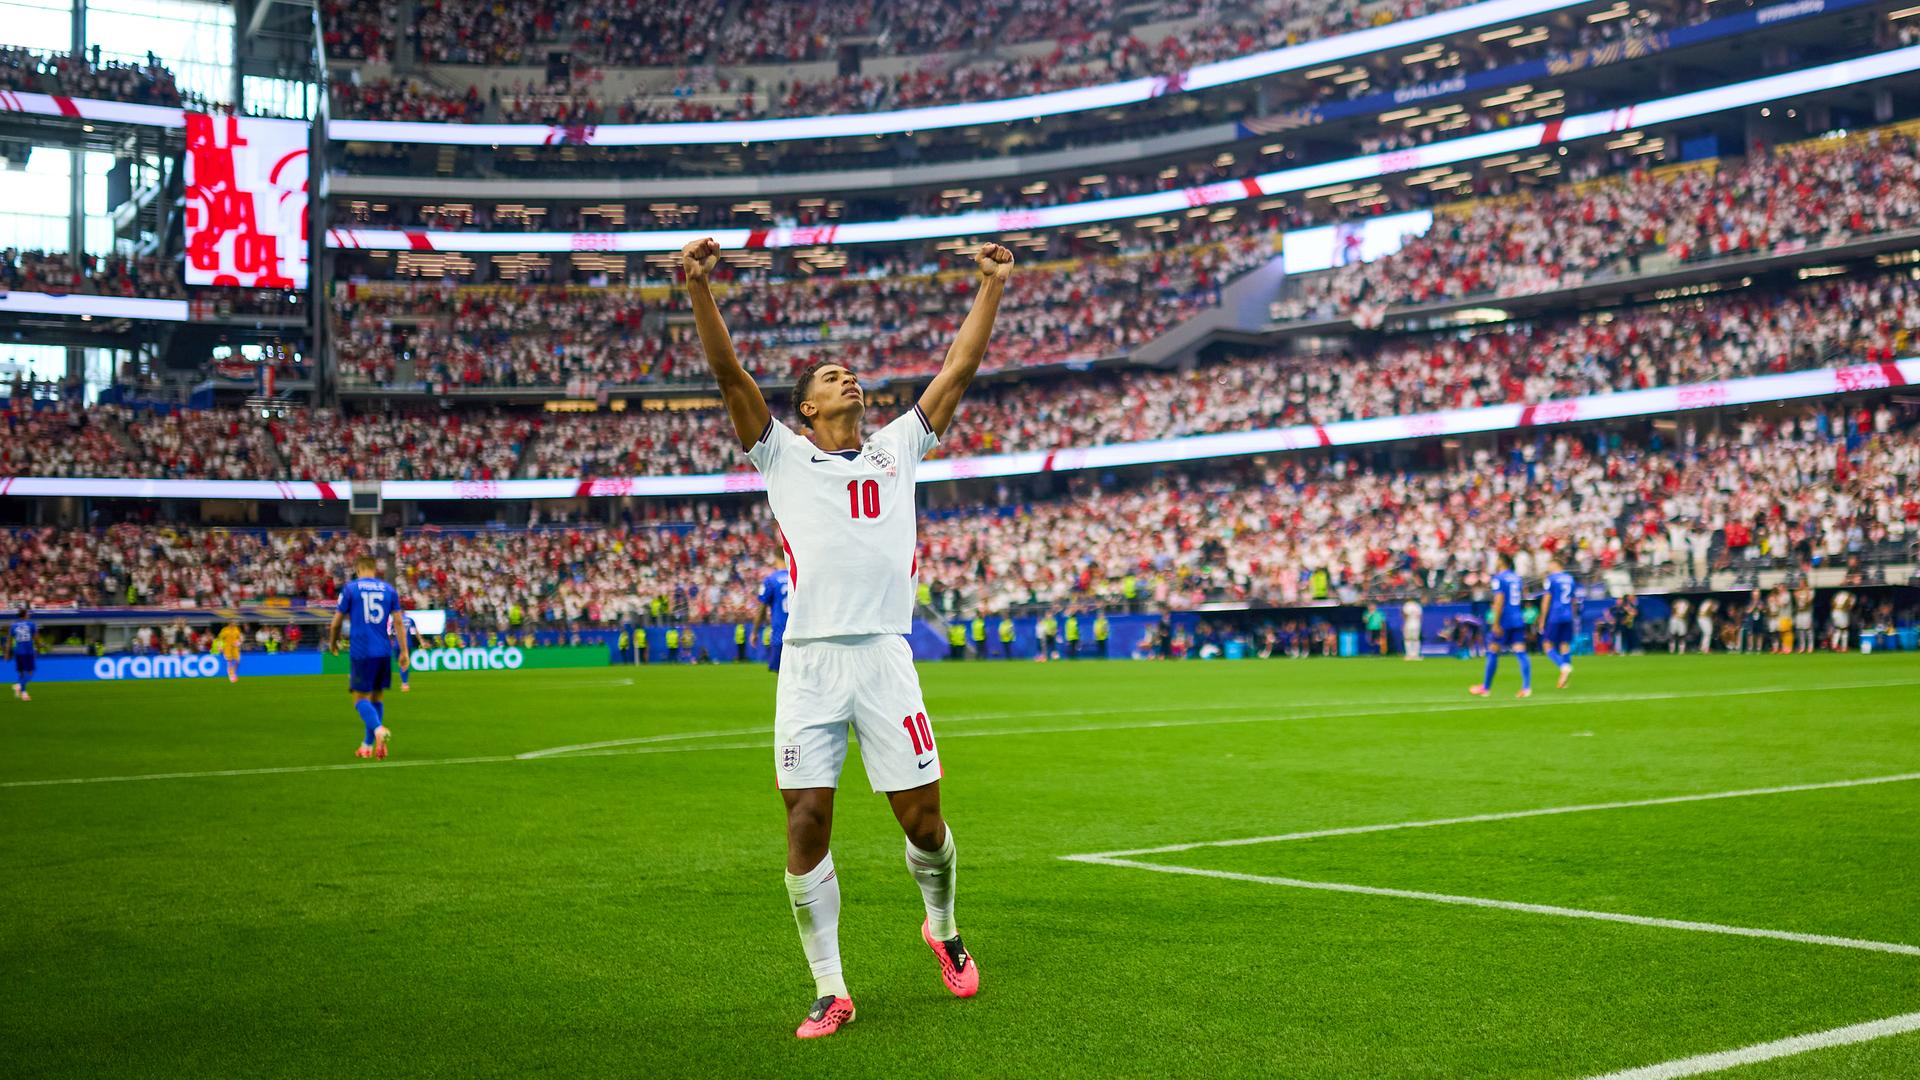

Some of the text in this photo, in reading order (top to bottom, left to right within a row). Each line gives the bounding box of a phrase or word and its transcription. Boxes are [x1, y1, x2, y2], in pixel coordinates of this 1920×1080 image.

[847, 479, 881, 519] 10
[360, 591, 384, 624] 15
[1560, 583, 1571, 604] 2
[94, 655, 220, 679] aramco
[410, 646, 523, 671] aramco
[902, 711, 934, 756] 10
